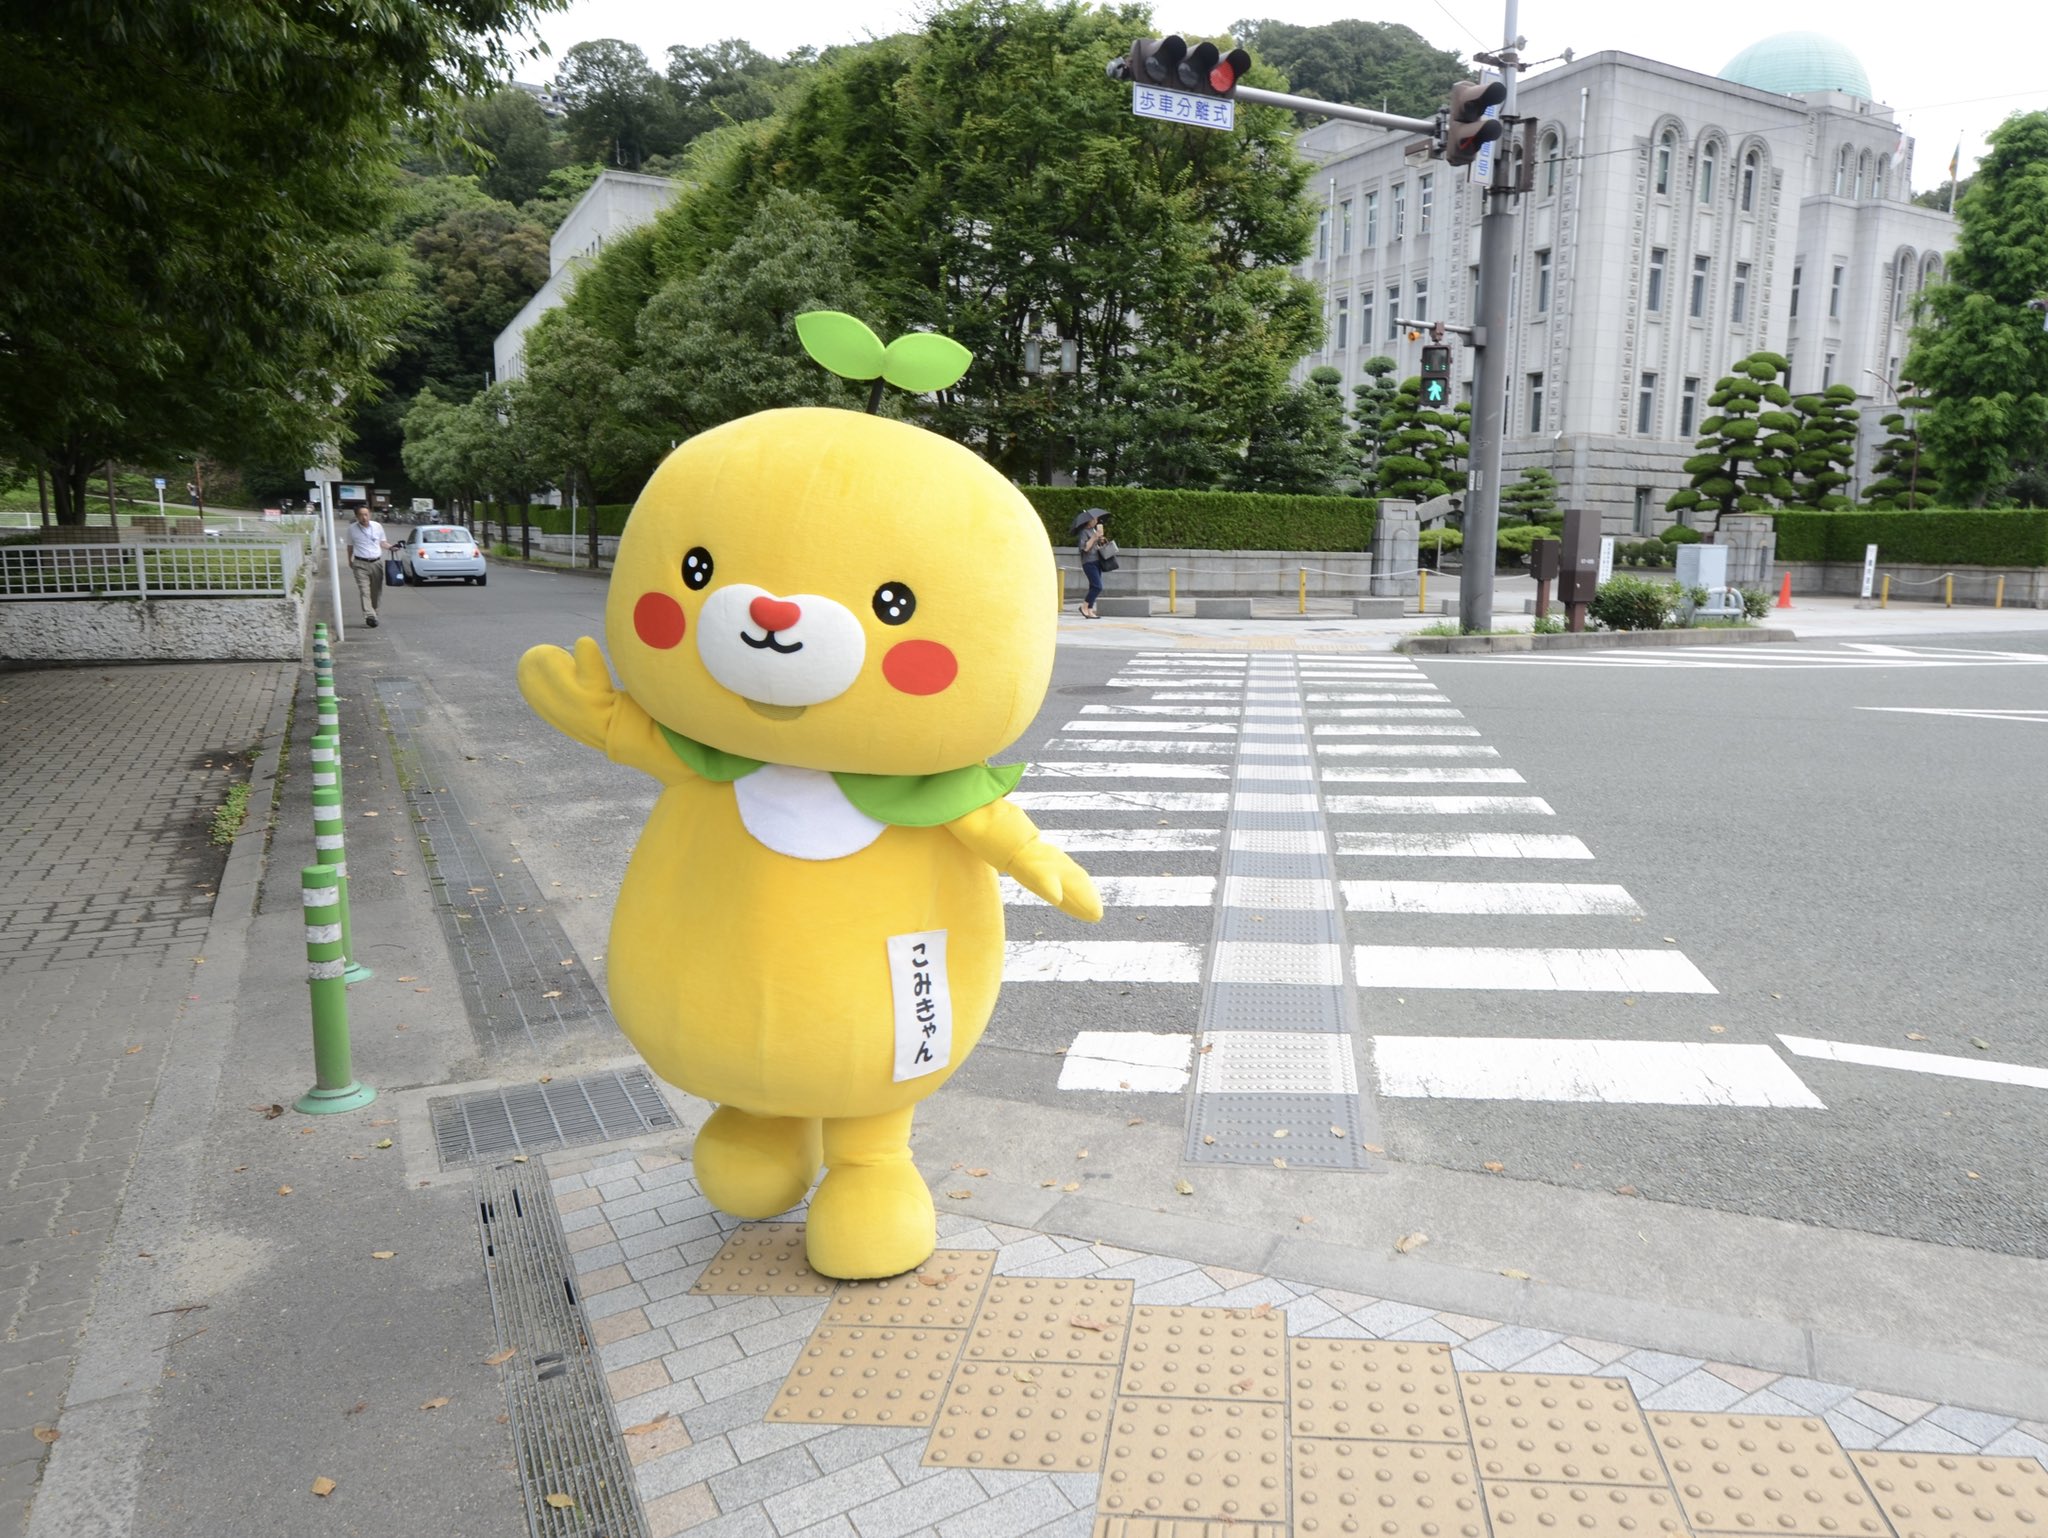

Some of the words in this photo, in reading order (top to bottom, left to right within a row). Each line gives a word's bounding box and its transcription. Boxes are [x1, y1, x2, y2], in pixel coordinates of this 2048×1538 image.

[1140, 91, 1228, 124] 歩車分離式
[912, 942, 936, 1064] こみきゃん
